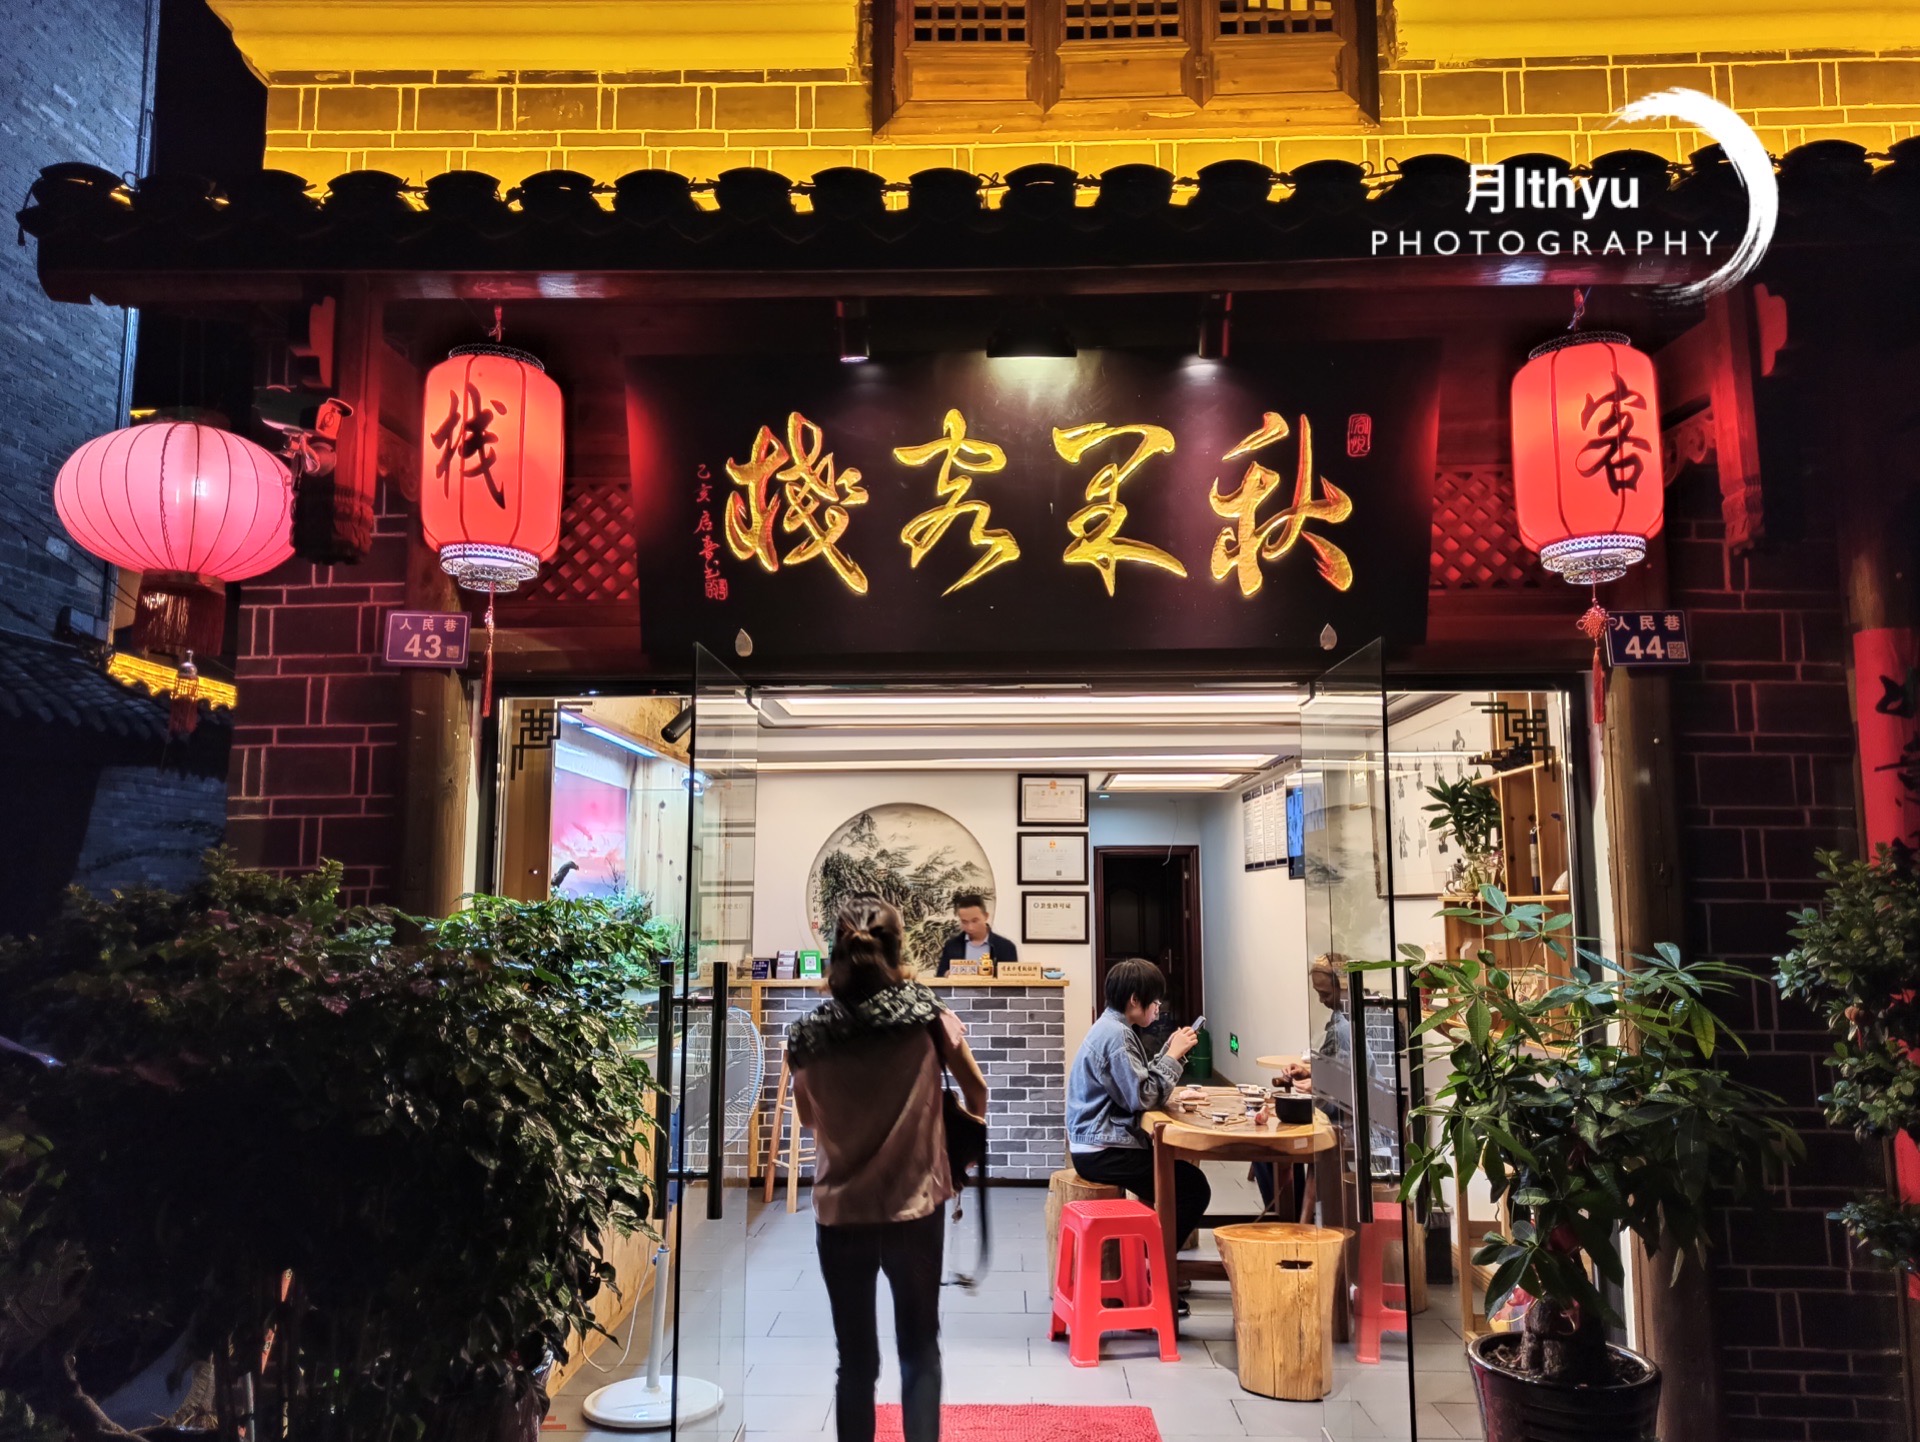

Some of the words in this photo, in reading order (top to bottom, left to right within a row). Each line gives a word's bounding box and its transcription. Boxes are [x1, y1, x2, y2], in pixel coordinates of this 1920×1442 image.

[430, 382, 508, 510] 栈
[1575, 371, 1652, 496] 客
[398, 616, 459, 633] 人民巷
[1614, 614, 1681, 632] 人民巷
[403, 633, 443, 660] 43
[1624, 635, 1666, 660] 44
